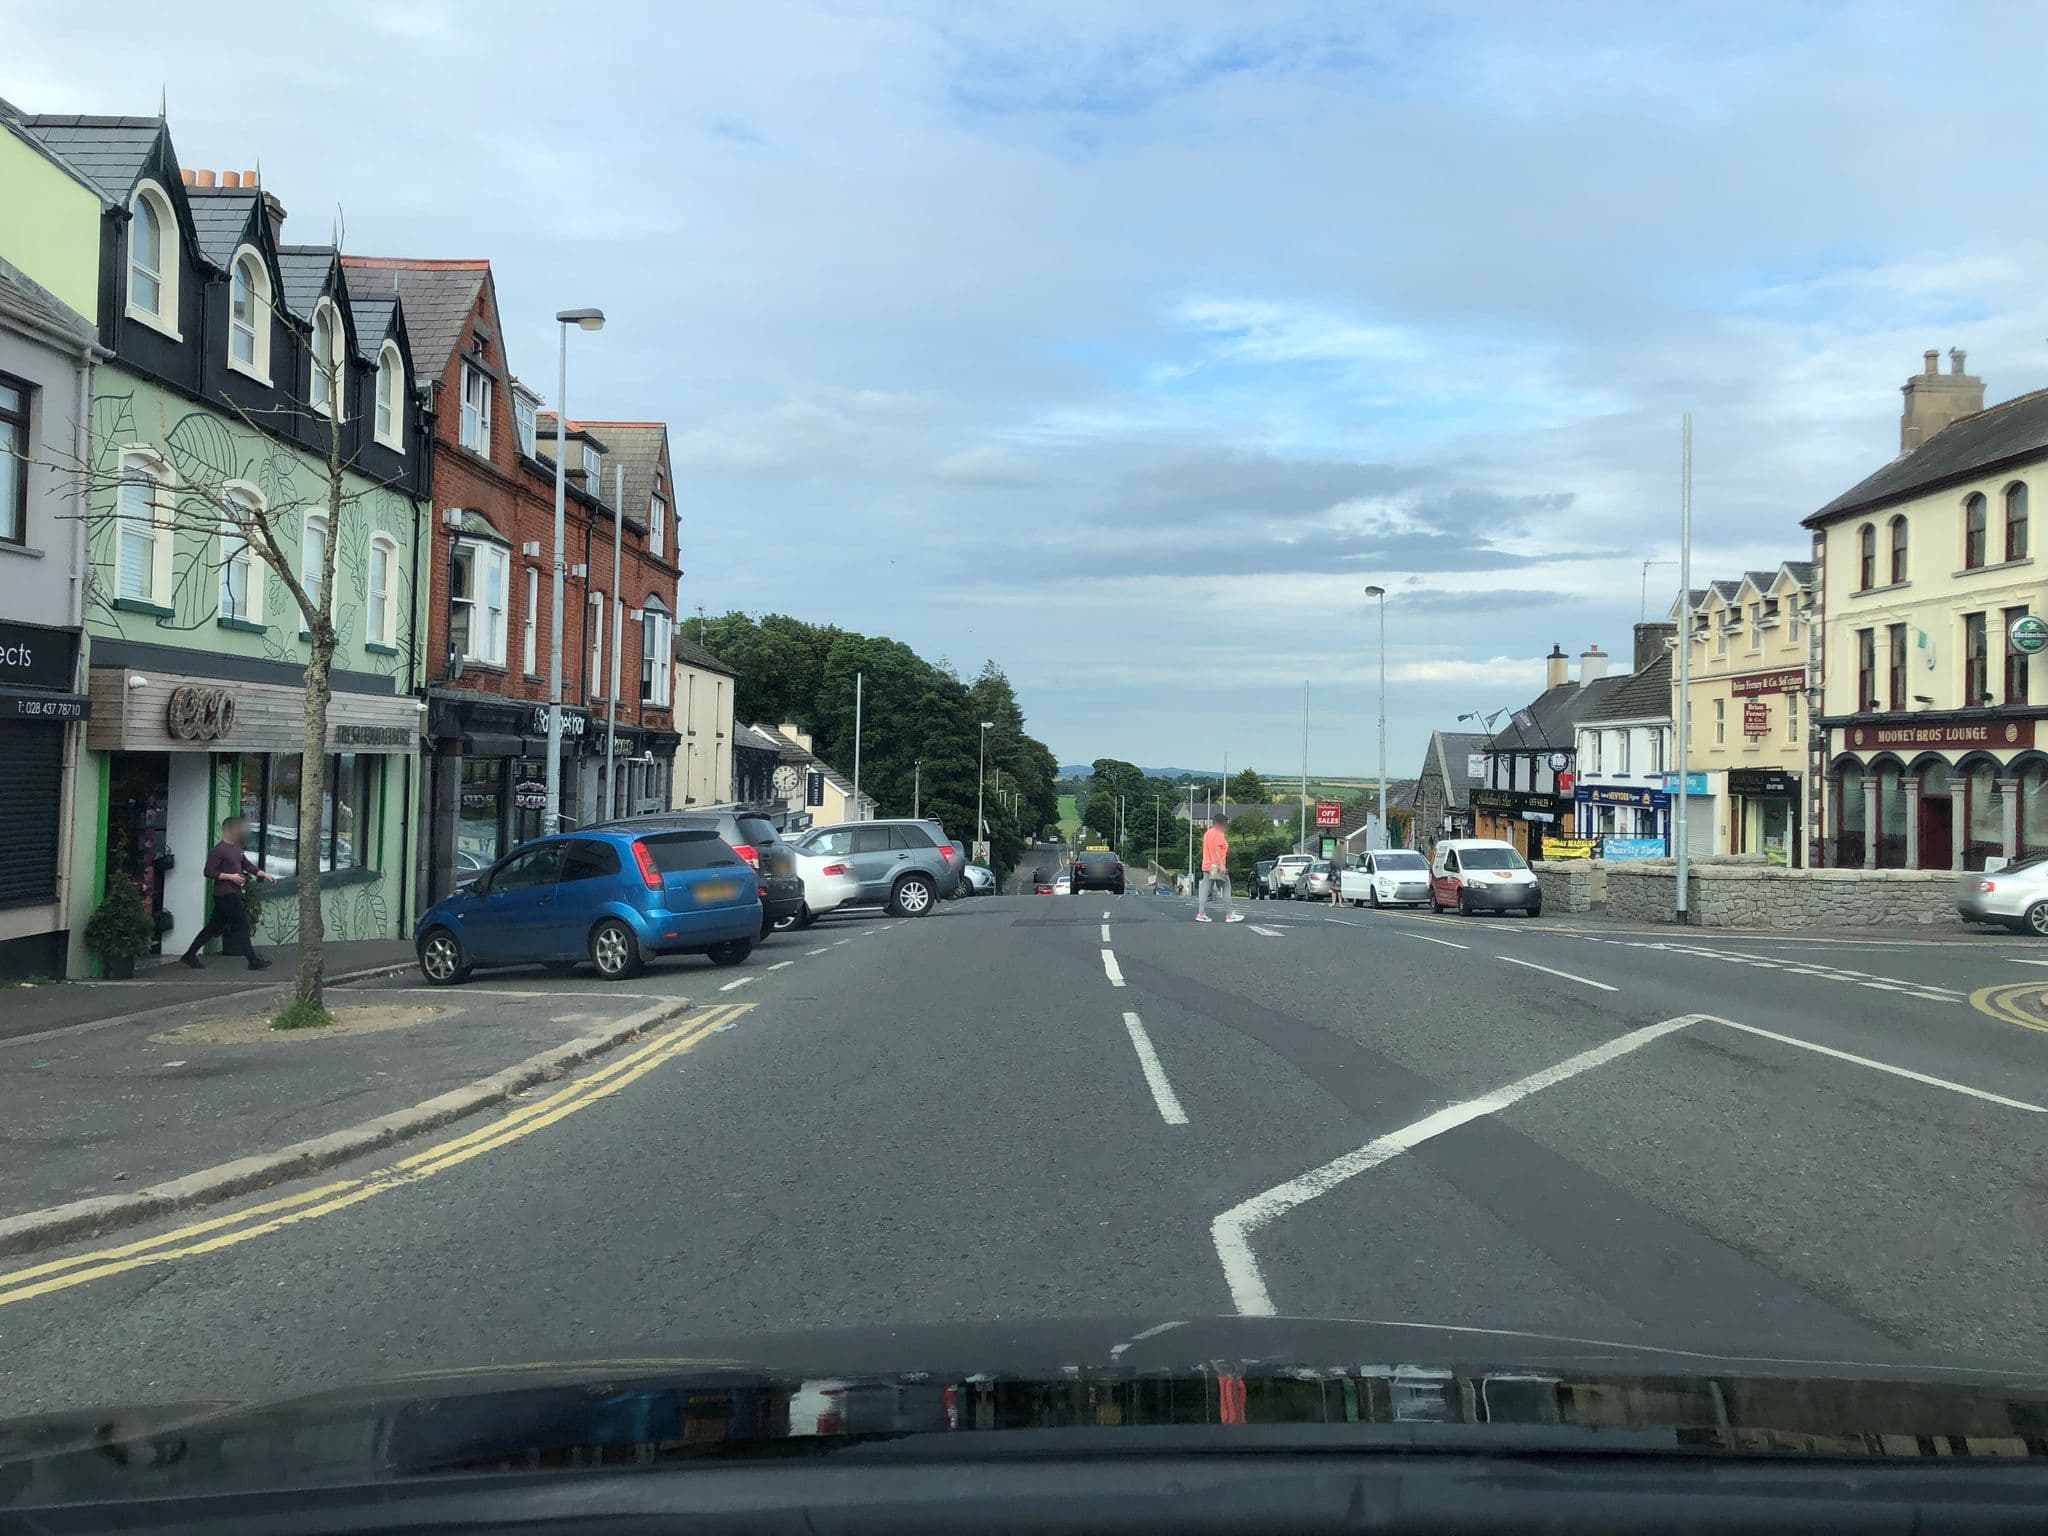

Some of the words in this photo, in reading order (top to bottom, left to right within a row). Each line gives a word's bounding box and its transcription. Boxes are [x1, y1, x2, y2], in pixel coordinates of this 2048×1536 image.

[17, 701, 25, 713] T:
[25, 701, 41, 714] 028
[42, 702, 57, 715] 437
[58, 703, 80, 716] 78710
[1878, 727, 1916, 742] MOONEY
[1916, 727, 1944, 742] BROS'
[1946, 726, 1988, 741] LOUNGE
[1318, 817, 1339, 825] SALES
[1605, 846, 1639, 857] Charity
